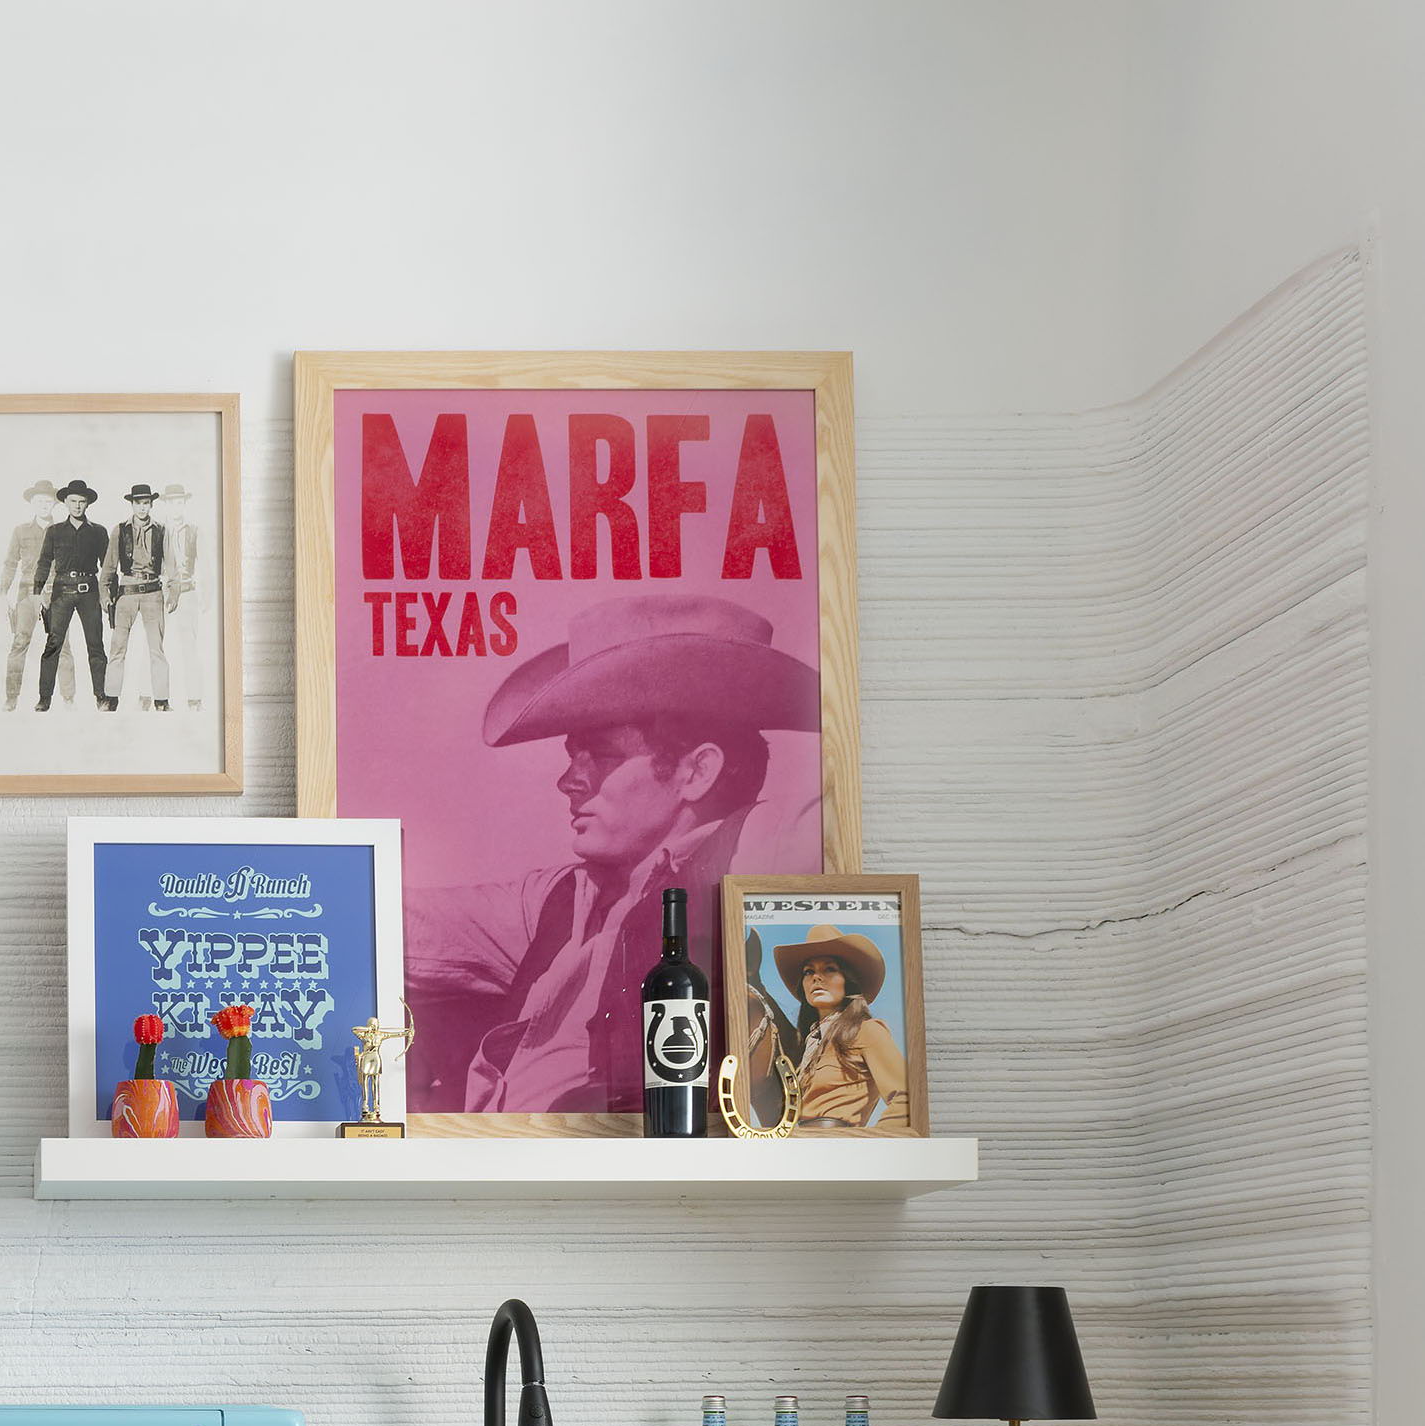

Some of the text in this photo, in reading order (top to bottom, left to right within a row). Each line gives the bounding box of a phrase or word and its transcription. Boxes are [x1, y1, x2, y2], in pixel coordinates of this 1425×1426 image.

[361, 413, 803, 580] MARFA
[363, 591, 518, 658] TEXAS
[159, 873, 224, 898] Double
[251, 873, 311, 898] Ranch
[743, 901, 900, 911] WESTERN
[138, 928, 329, 989] YIPPEE
[170, 1056, 189, 1077] The
[252, 1052, 302, 1079] Best
